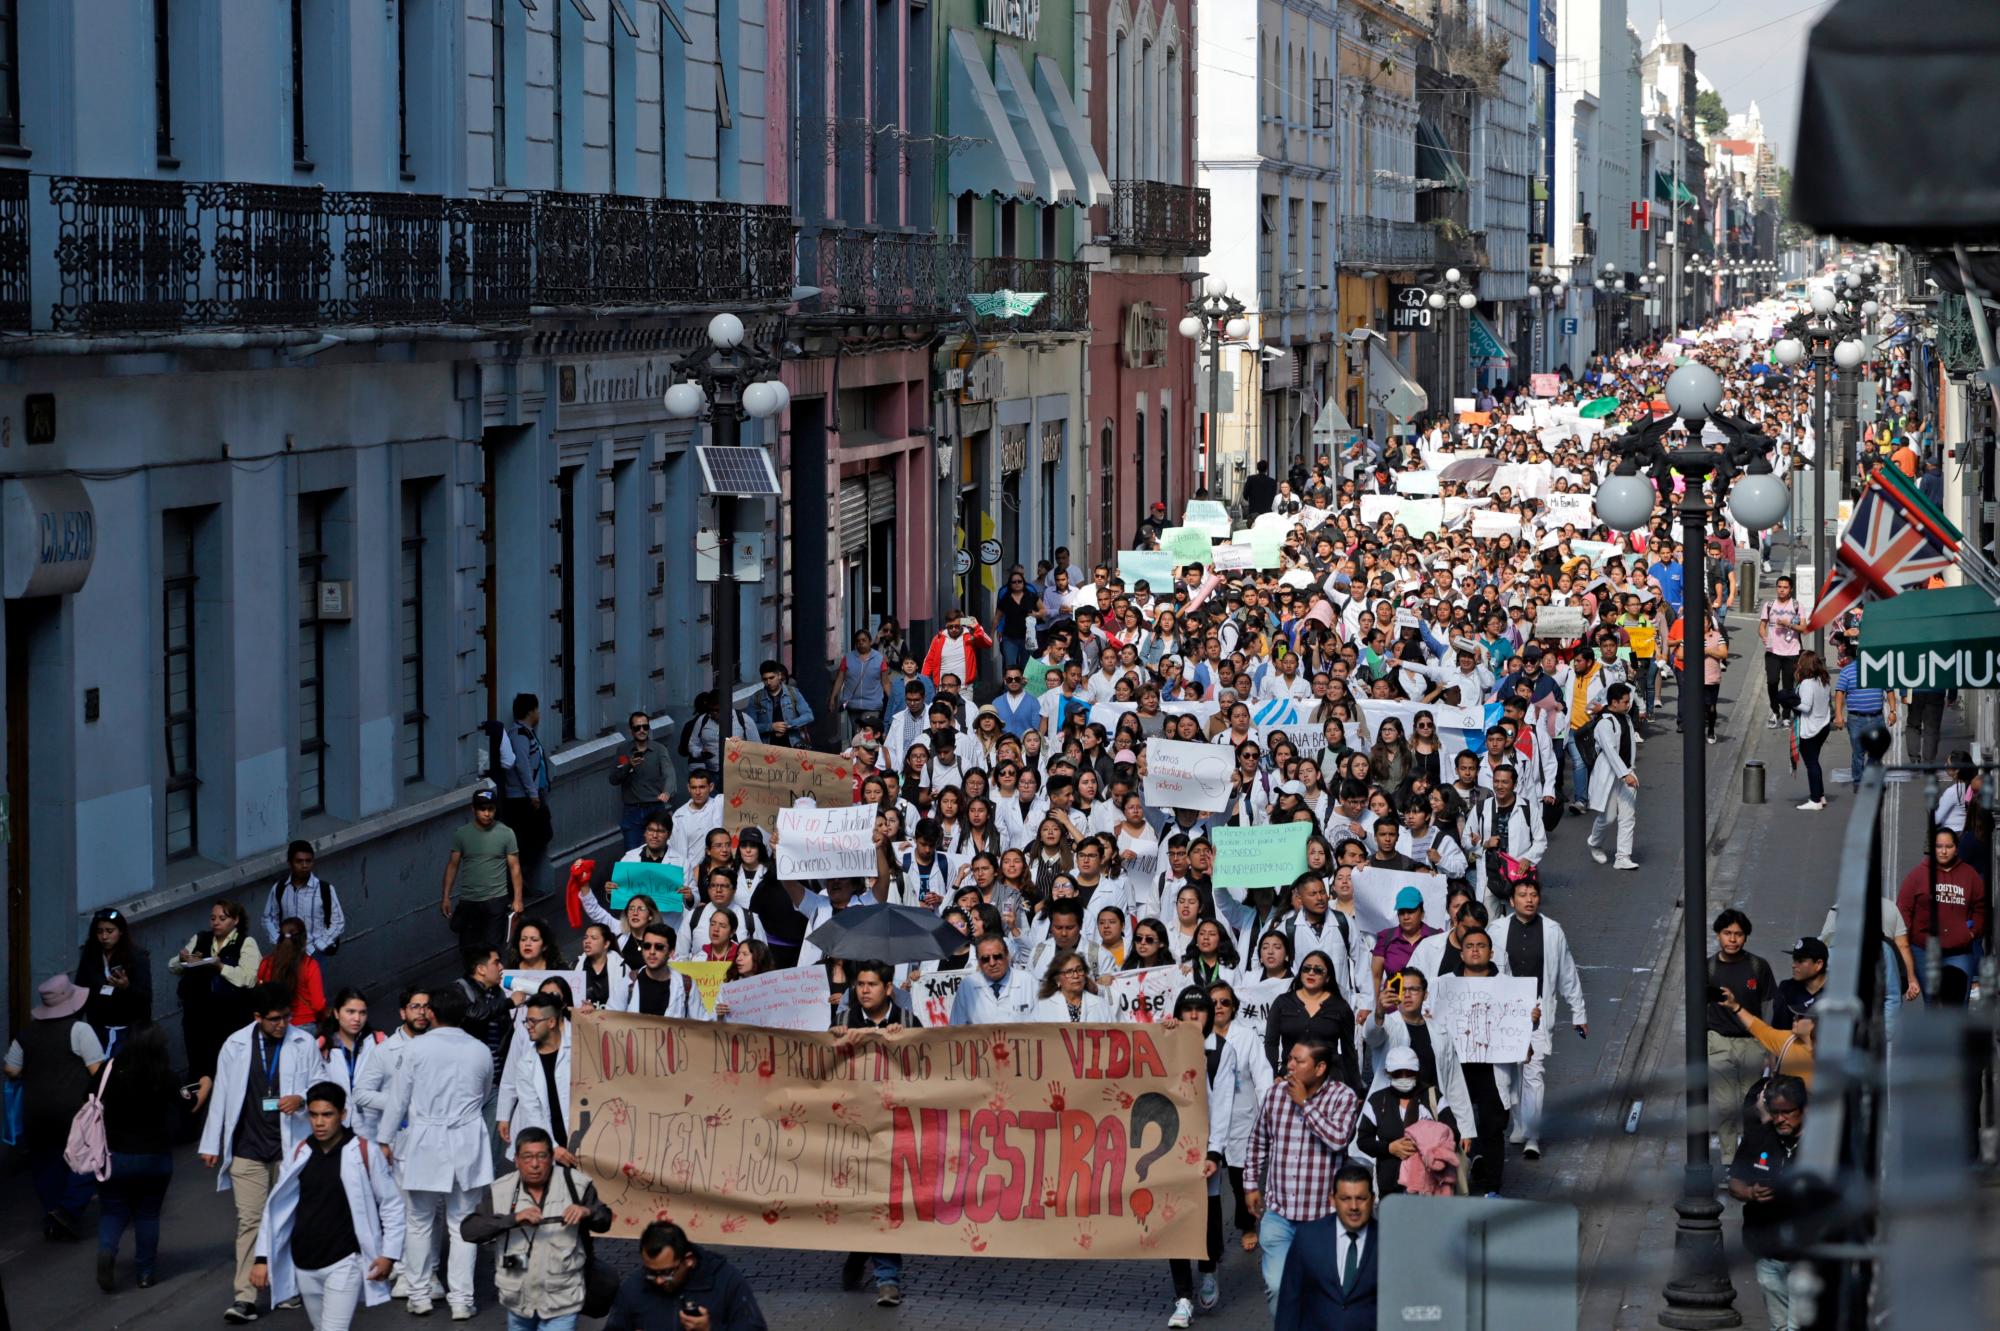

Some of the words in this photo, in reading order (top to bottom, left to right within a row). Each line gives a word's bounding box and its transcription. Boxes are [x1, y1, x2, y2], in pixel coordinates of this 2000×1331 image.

[1631, 201, 1649, 230] H
[1394, 309, 1431, 326] HIPO
[1565, 319, 1574, 333] E
[584, 364, 640, 402] Sucursal
[41, 511, 93, 564] CAJERO
[1860, 650, 2000, 688] MUMU
[1155, 750, 1179, 765] Somos
[738, 755, 763, 781] Que
[767, 763, 800, 789] portar
[1153, 766, 1193, 779] estudiantes
[739, 810, 759, 825] me
[1936, 894, 1965, 905] OLLEGE
[1119, 991, 1166, 1012] José
[577, 1023, 689, 1084] NOSOTROS
[713, 1028, 758, 1074] NOS
[945, 1038, 990, 1082] POR
[1008, 1038, 1043, 1081] TU
[1060, 1027, 1168, 1079] VIDA
[737, 1117, 807, 1196] POR
[822, 1122, 871, 1198] LA
[889, 1092, 1180, 1233] NUESTRA?
